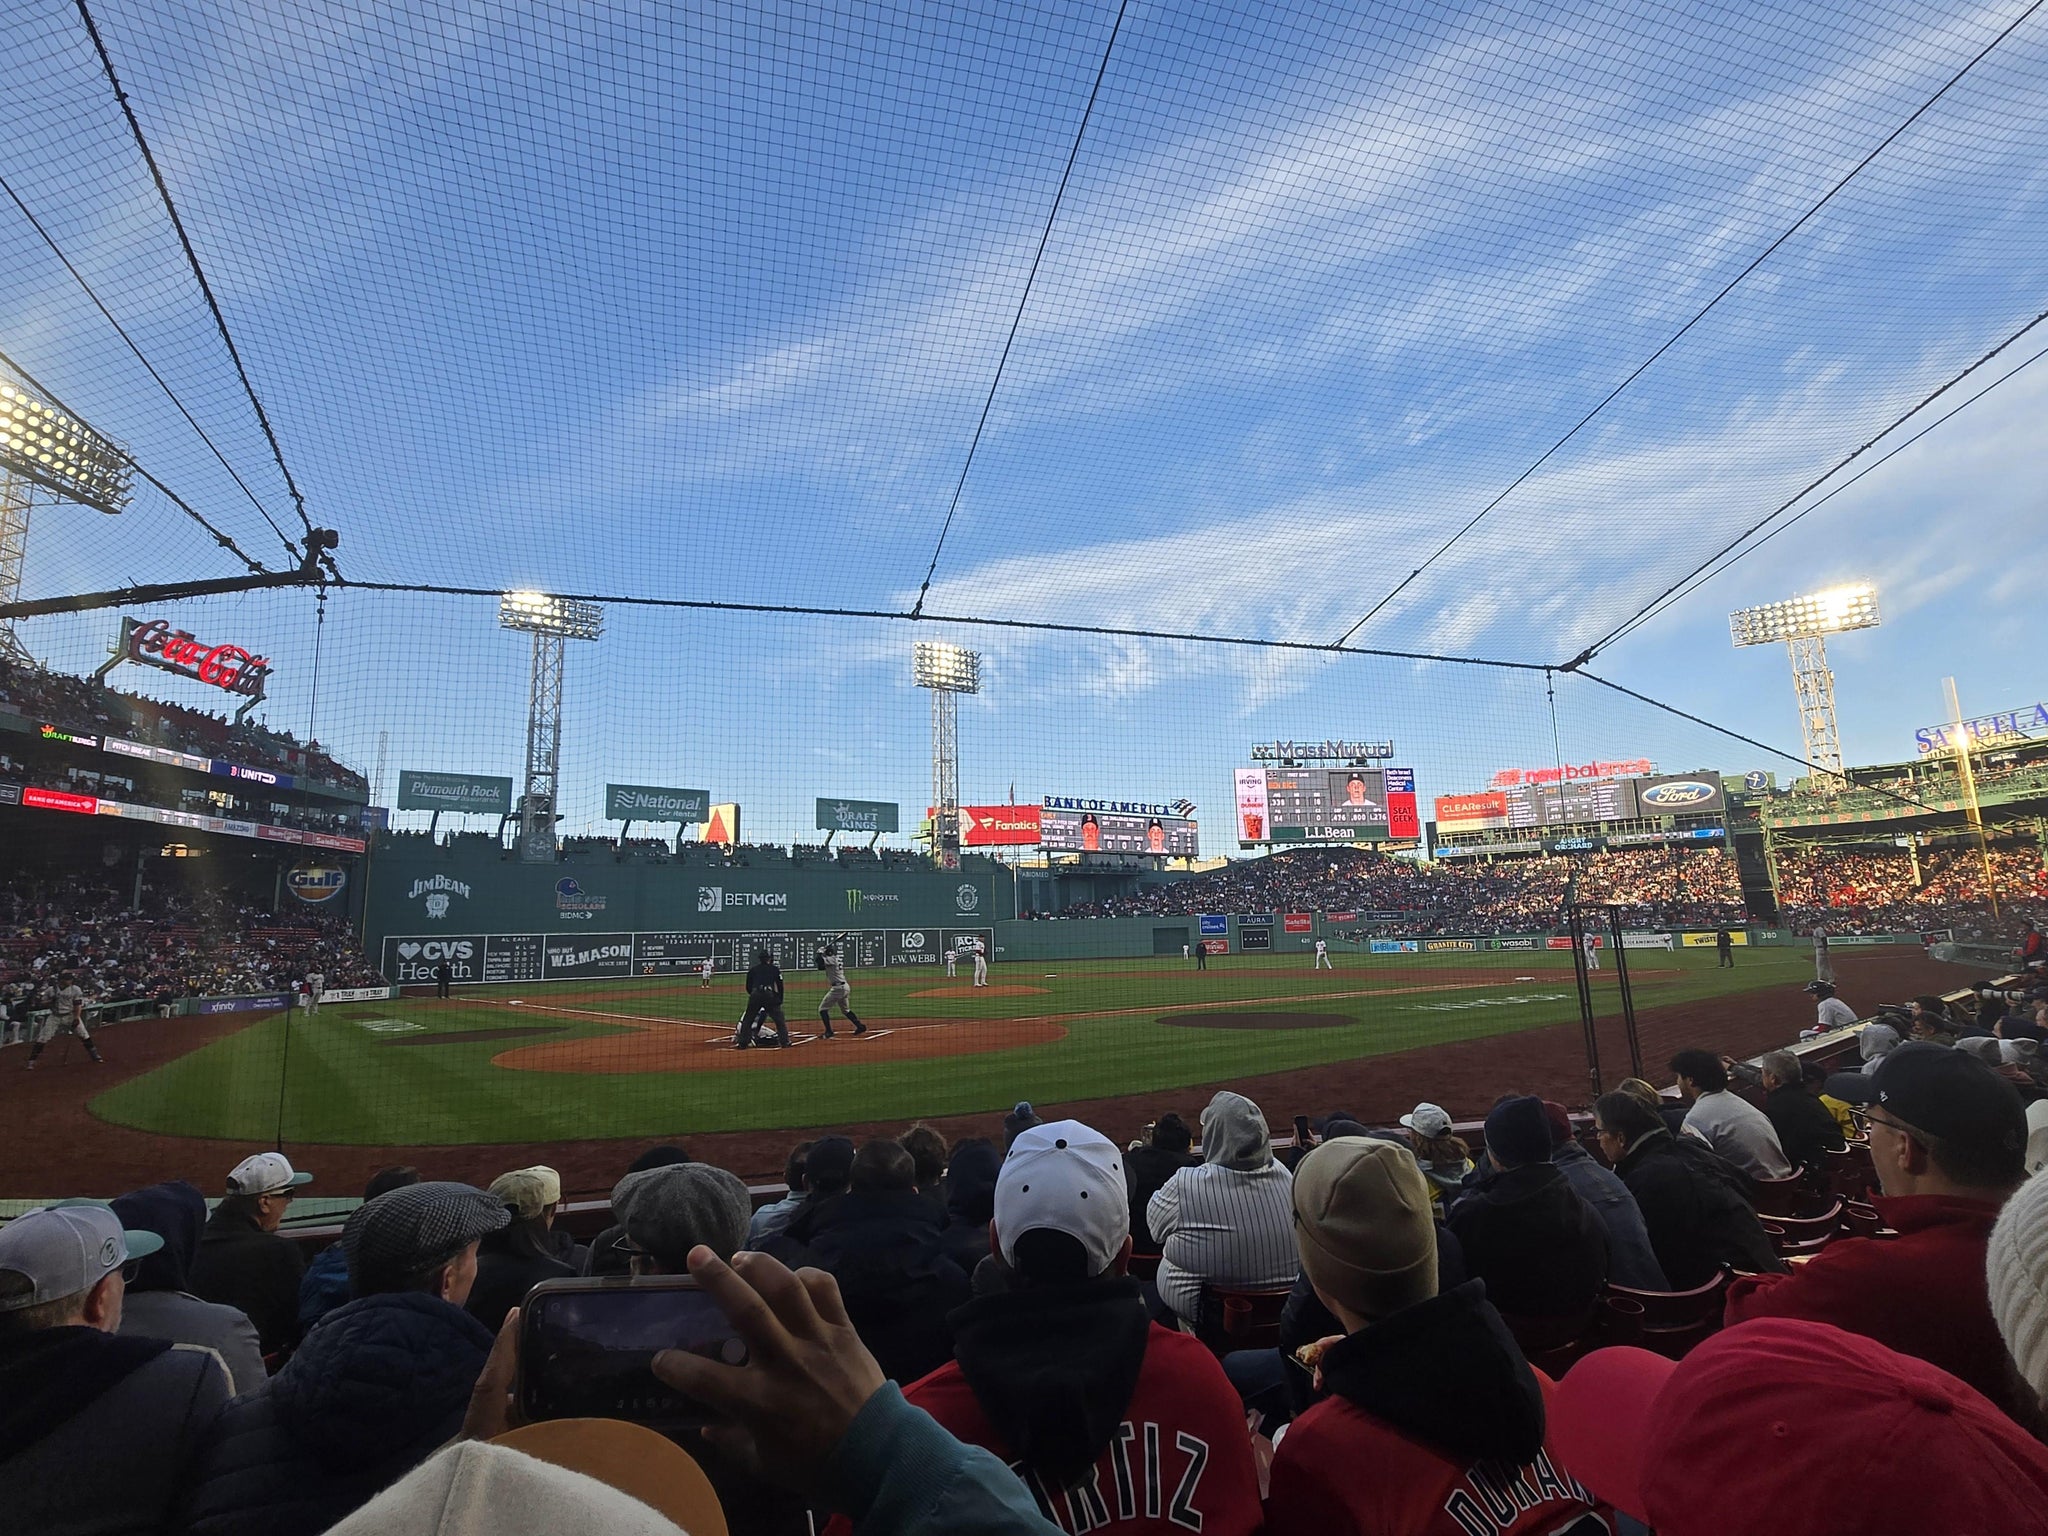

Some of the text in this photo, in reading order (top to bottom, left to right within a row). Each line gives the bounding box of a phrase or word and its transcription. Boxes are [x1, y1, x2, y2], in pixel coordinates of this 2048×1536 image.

[130, 619, 269, 697] Coca-Cola
[1275, 739, 1394, 759] MassMutual
[1525, 758, 1651, 783] new balance
[411, 781, 500, 798] Plymouth Rock
[1656, 783, 1700, 802] Ford
[55, 799, 81, 808] AMERICA
[1044, 795, 1170, 816] BANK OF AMERICA
[1442, 800, 1500, 813] CLEAResult
[673, 810, 698, 818] Rental
[1393, 806, 1412, 814] SEAT
[836, 811, 879, 821] DRAFT
[1331, 814, 1346, 822] .476
[1393, 814, 1414, 823] GEEK
[841, 820, 878, 830] KINGS
[995, 819, 1039, 831] Fanatics
[1305, 826, 1355, 839] L.L.Bean
[1107, 841, 1141, 850] 0 0 2
[1554, 842, 1593, 850] ORCHARD
[290, 872, 343, 887] Gulf
[725, 893, 787, 906] BETMGM
[1373, 942, 1398, 951] jetBlue
[1458, 941, 1473, 949] CITY
[1501, 938, 1532, 947] wasabi
[422, 941, 474, 960] CVS
[891, 953, 936, 964] F.W. WEBB
[643, 966, 654, 974] 22
[211, 1002, 236, 1012] xfinity
